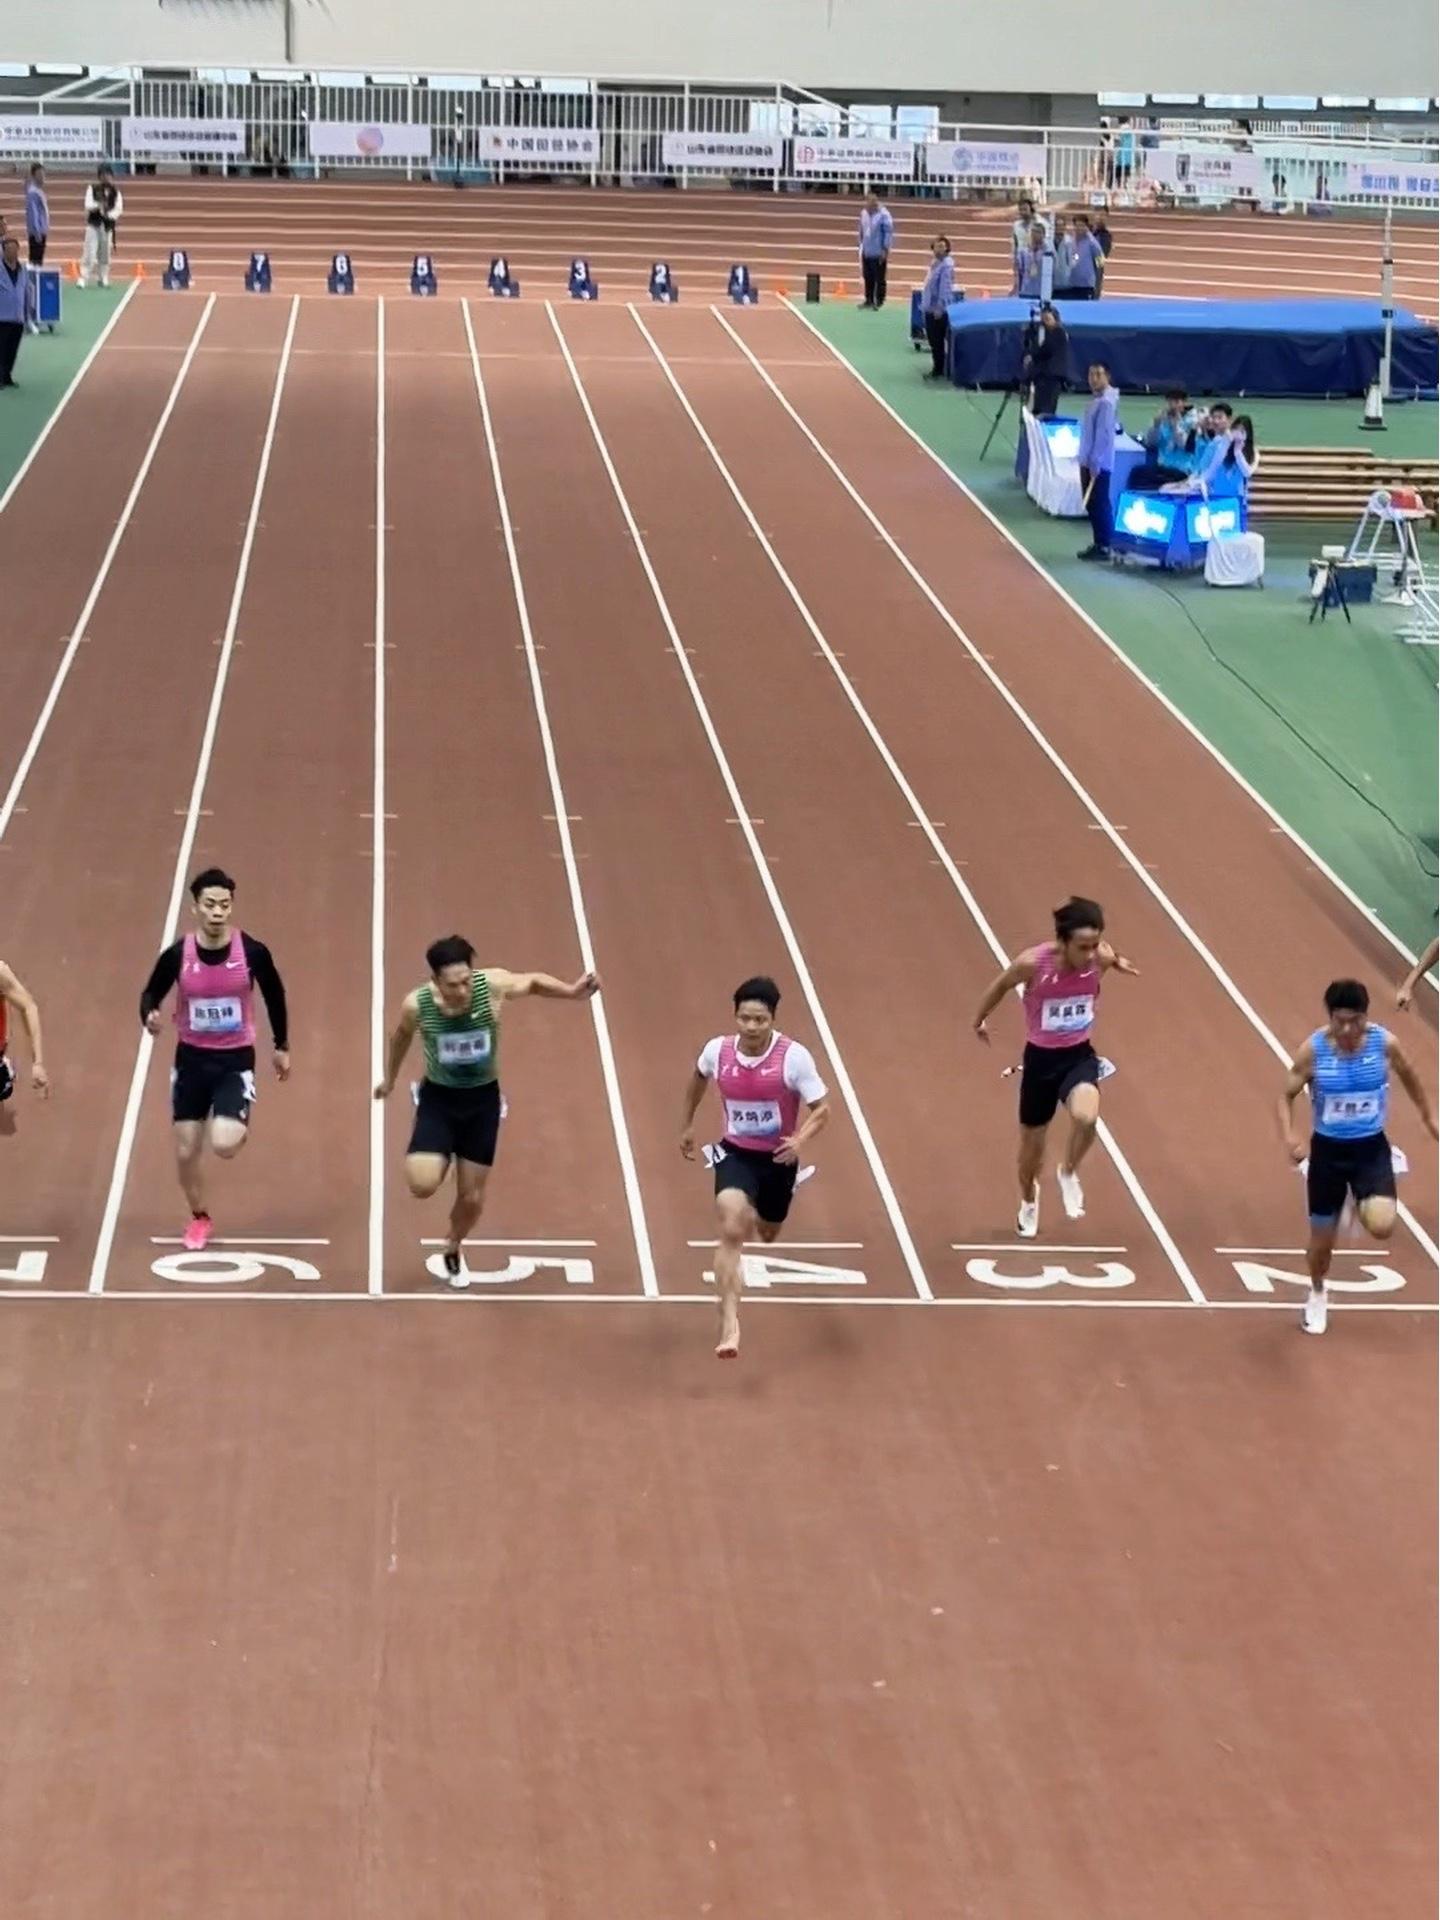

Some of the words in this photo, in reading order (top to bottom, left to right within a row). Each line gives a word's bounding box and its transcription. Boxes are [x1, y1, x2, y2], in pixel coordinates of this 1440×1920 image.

[507, 137, 592, 153] 中国田径协会
[173, 252, 184, 271] 8
[254, 254, 265, 273] 7
[336, 256, 347, 274] 6
[417, 257, 428, 276] 5
[494, 259, 505, 278] 4
[575, 260, 586, 280] 3
[655, 263, 666, 283] 2
[734, 265, 744, 284] 1
[151, 1251, 321, 1283] 6
[425, 1253, 594, 1286] 5
[702, 1254, 867, 1287] 4
[966, 1258, 1136, 1289] 3
[1232, 1261, 1407, 1292] 2
